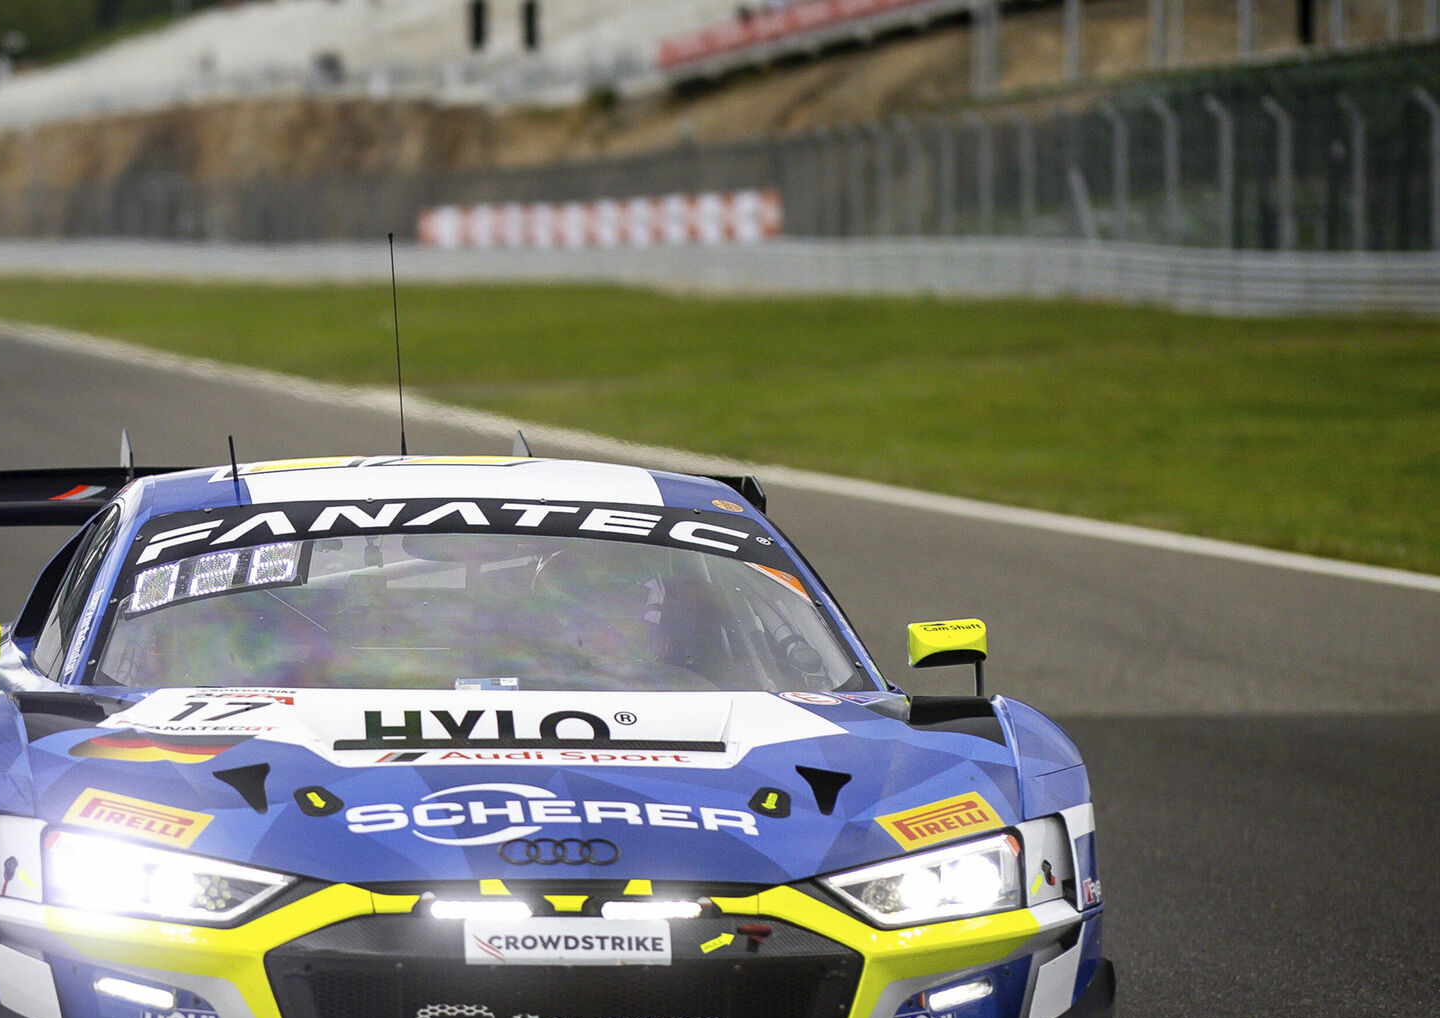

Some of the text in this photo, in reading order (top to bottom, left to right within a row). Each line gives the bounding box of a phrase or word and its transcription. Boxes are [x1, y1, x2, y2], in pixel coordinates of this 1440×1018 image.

[136, 501, 750, 565] FANATEC
[168, 702, 273, 721] 17
[440, 751, 691, 763] Audi Sport
[79, 797, 194, 838] PIRELLI
[345, 799, 759, 836] SCHERER
[891, 800, 990, 841] PIRELLI
[488, 934, 664, 952] CROWDSTRIKE
